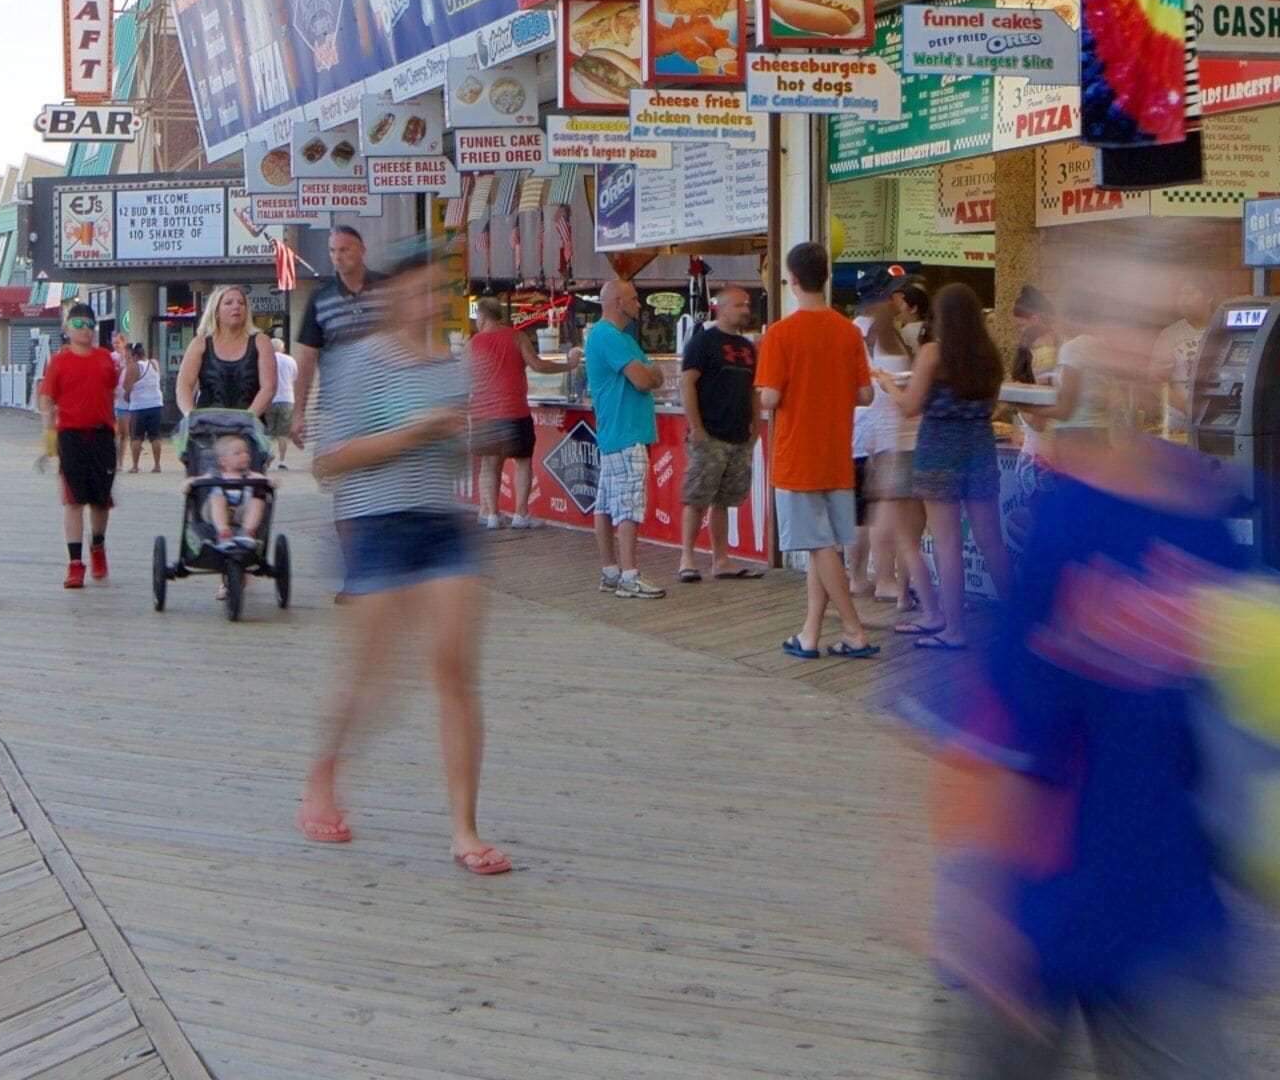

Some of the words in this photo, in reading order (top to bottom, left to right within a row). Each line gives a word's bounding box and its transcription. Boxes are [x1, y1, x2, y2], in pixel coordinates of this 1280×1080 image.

[923, 9, 984, 27] funnel
[992, 13, 1042, 30] cakes
[929, 36, 956, 48] DEEP
[957, 33, 988, 44] FRIED
[986, 32, 1042, 54] OREO
[751, 56, 877, 78] cheeseburgers
[913, 52, 961, 67] World's
[967, 53, 1018, 72] Largest
[1023, 55, 1053, 70] Slice
[777, 76, 805, 91] hot
[812, 77, 853, 97] dogs
[1223, 78, 1271, 102] LARGEST
[649, 94, 699, 108] cheese
[705, 94, 741, 108] fries
[751, 95, 768, 107] Air
[1013, 88, 1022, 109] 3
[49, 109, 132, 135] BAR
[636, 110, 692, 125] chicken
[696, 111, 753, 126] tenders
[1016, 104, 1072, 139] PIZZA
[553, 132, 601, 145] sausage
[633, 126, 650, 138] Air
[459, 136, 506, 149] FUNNEL
[510, 135, 541, 148] CAKE
[931, 139, 951, 158] PIZZA
[460, 151, 502, 164] FRIED
[505, 149, 542, 163] OREO
[553, 147, 589, 159] world's
[592, 147, 626, 162] largest
[630, 147, 657, 162] pizza
[373, 161, 413, 174] CHEESE
[415, 160, 446, 173] BALLS
[1057, 163, 1067, 185] 3
[373, 174, 414, 187] CHEESE
[417, 174, 446, 187] FRIES
[301, 183, 331, 195] CHEESE
[332, 183, 368, 194] BURGERS
[600, 168, 633, 210] OREO
[70, 195, 103, 214] EJ's
[146, 193, 189, 204] WELCOME
[256, 199, 297, 209] CHEESEST
[301, 195, 329, 207] HOT
[332, 194, 368, 207] DOGS
[1062, 187, 1124, 216] PIZZA
[131, 206, 147, 216] BUD
[158, 205, 170, 216] BL
[174, 204, 221, 215] DRAUGHTS
[256, 209, 285, 219] ITALIAN
[285, 209, 319, 219] SAUSAGE
[140, 218, 157, 227] PBR
[164, 217, 204, 227] BOTTLES
[1250, 212, 1271, 231] Get
[149, 229, 184, 239] SHAKER
[191, 228, 202, 238] OF
[152, 240, 182, 251] SHOTS
[243, 244, 259, 254] POOL
[74, 250, 100, 259] FUN
[1235, 310, 1261, 324] ATM
[551, 497, 567, 512] PIZZA
[655, 508, 670, 525] PIZZA
